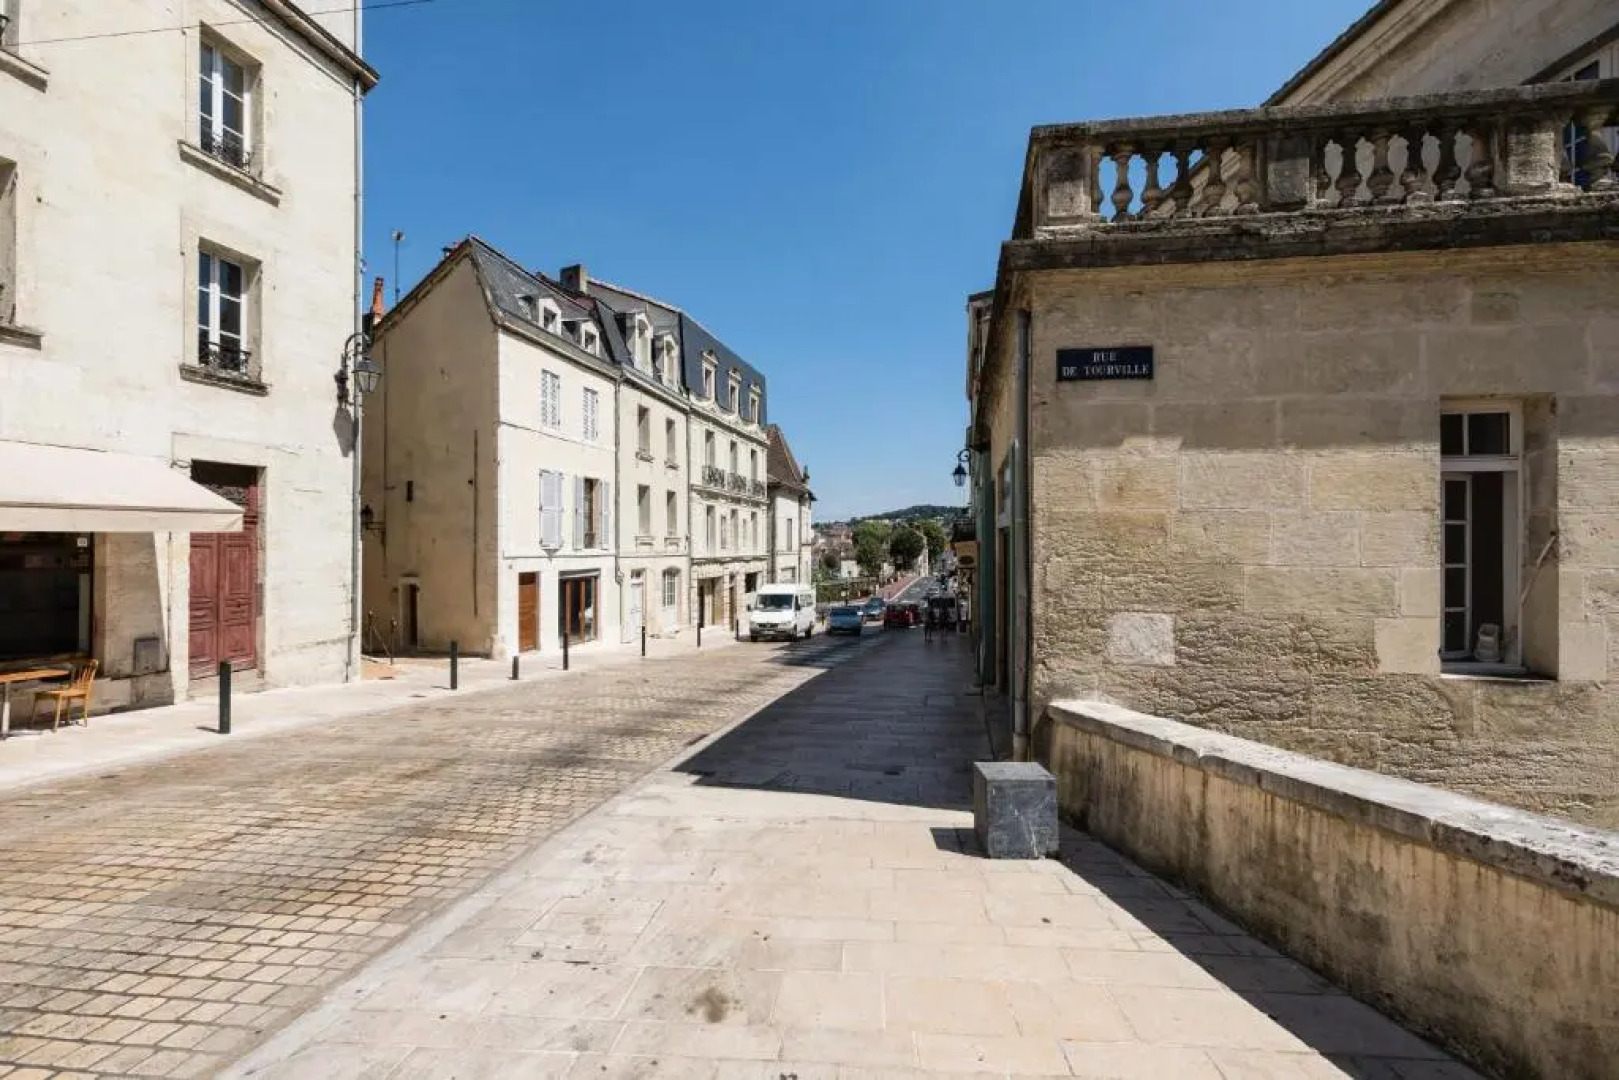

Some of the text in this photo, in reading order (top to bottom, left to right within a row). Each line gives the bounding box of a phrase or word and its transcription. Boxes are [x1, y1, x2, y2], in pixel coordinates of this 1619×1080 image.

[1093, 350, 1117, 363] RUE
[1062, 364, 1150, 376] DE TOURVILLE
